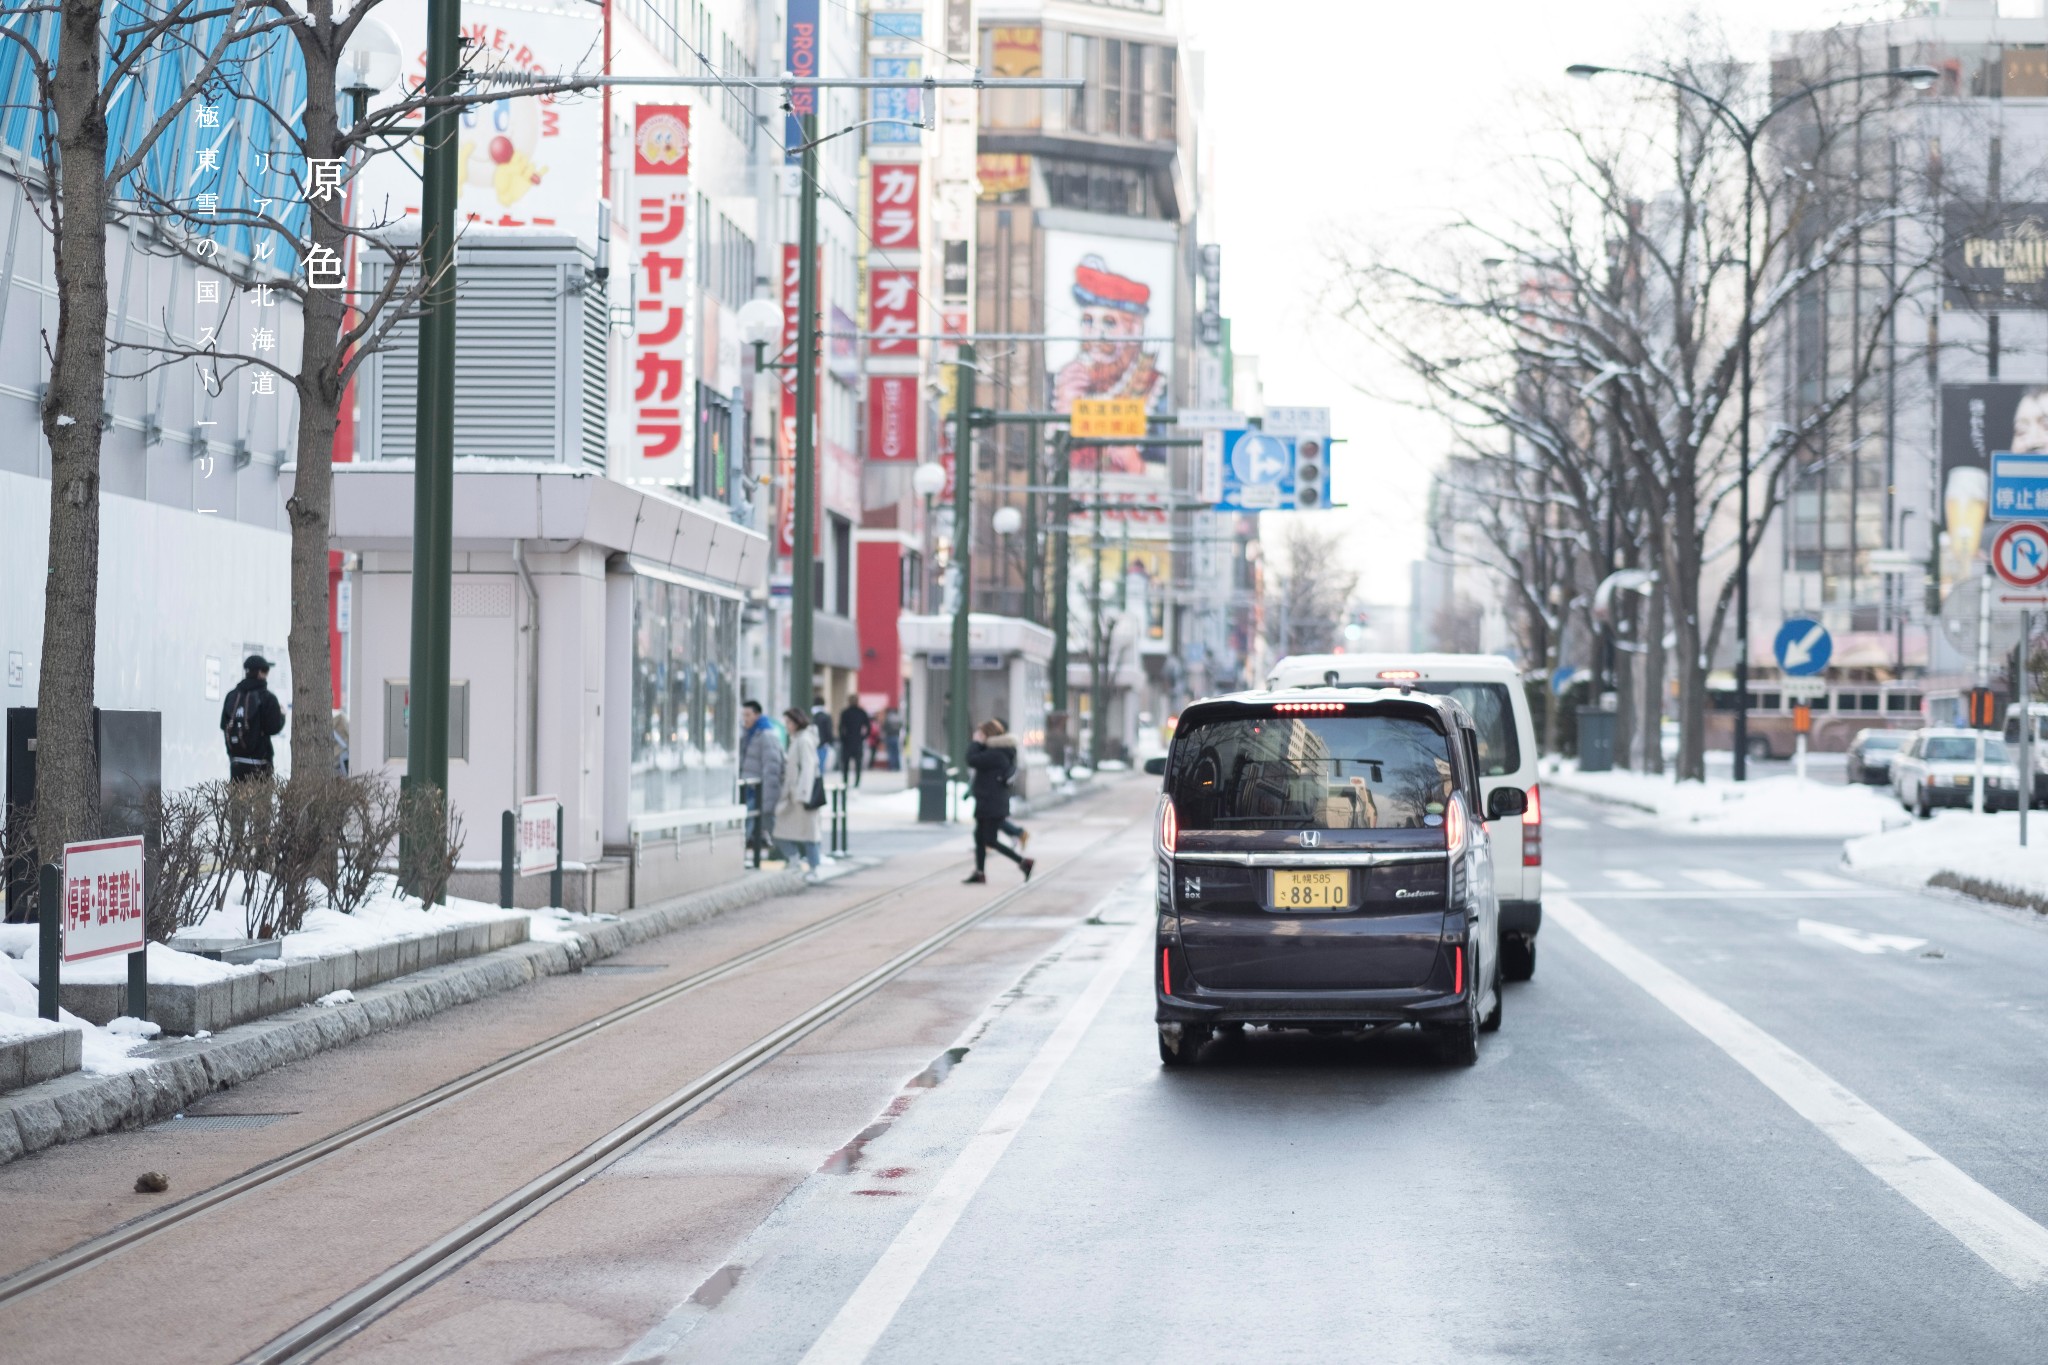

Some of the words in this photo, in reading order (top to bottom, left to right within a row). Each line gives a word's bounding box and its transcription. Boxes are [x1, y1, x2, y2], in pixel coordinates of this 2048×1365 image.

[1964, 239, 2048, 268] PREMI
[636, 193, 685, 458] ジャンカラ
[1291, 886, 1343, 904] 88-10
[1395, 889, 1440, 898] Custom
